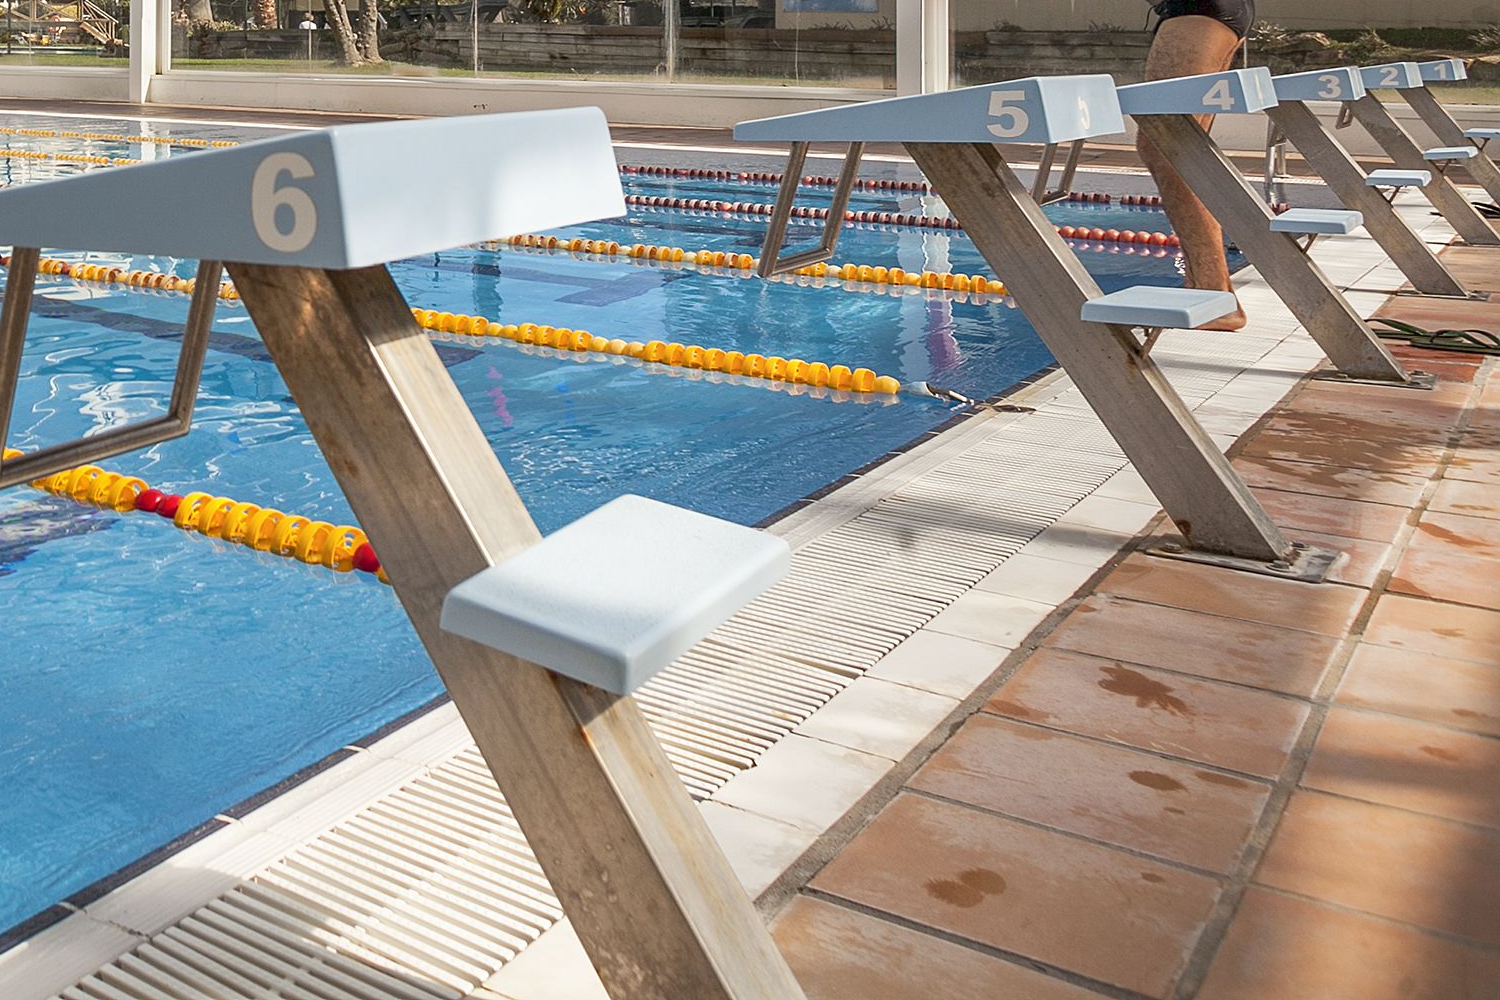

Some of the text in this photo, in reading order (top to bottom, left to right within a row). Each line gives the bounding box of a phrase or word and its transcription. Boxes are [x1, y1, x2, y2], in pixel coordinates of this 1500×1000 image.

[1379, 66, 1399, 86] 2
[1433, 63, 1447, 80] 1
[1202, 79, 1235, 111] 4
[1317, 74, 1342, 99] 3
[986, 90, 1029, 138] 5
[251, 151, 318, 253] 6
